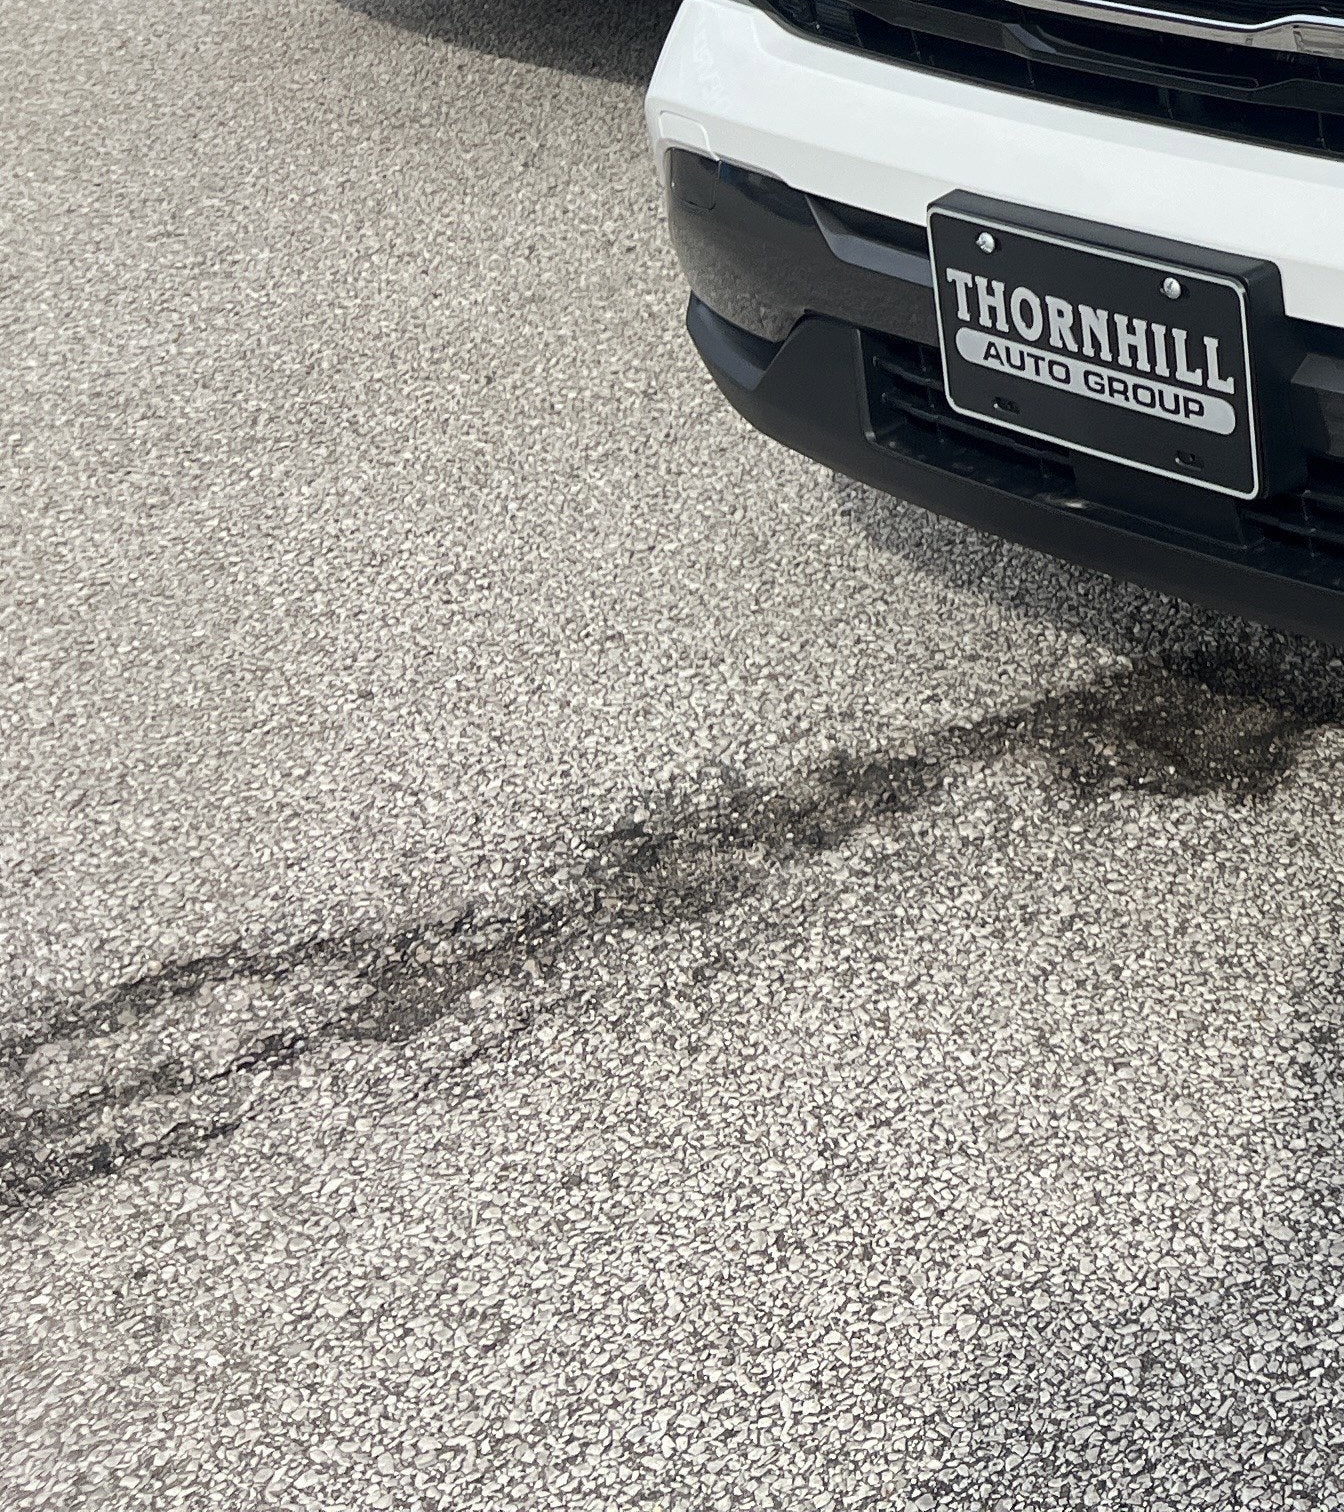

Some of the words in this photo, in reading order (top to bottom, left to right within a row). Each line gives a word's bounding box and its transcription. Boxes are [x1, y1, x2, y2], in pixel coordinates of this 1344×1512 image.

[946, 267, 1236, 395] THORNHILL
[982, 340, 1072, 385] AUTO
[1083, 369, 1206, 420] GROUP
